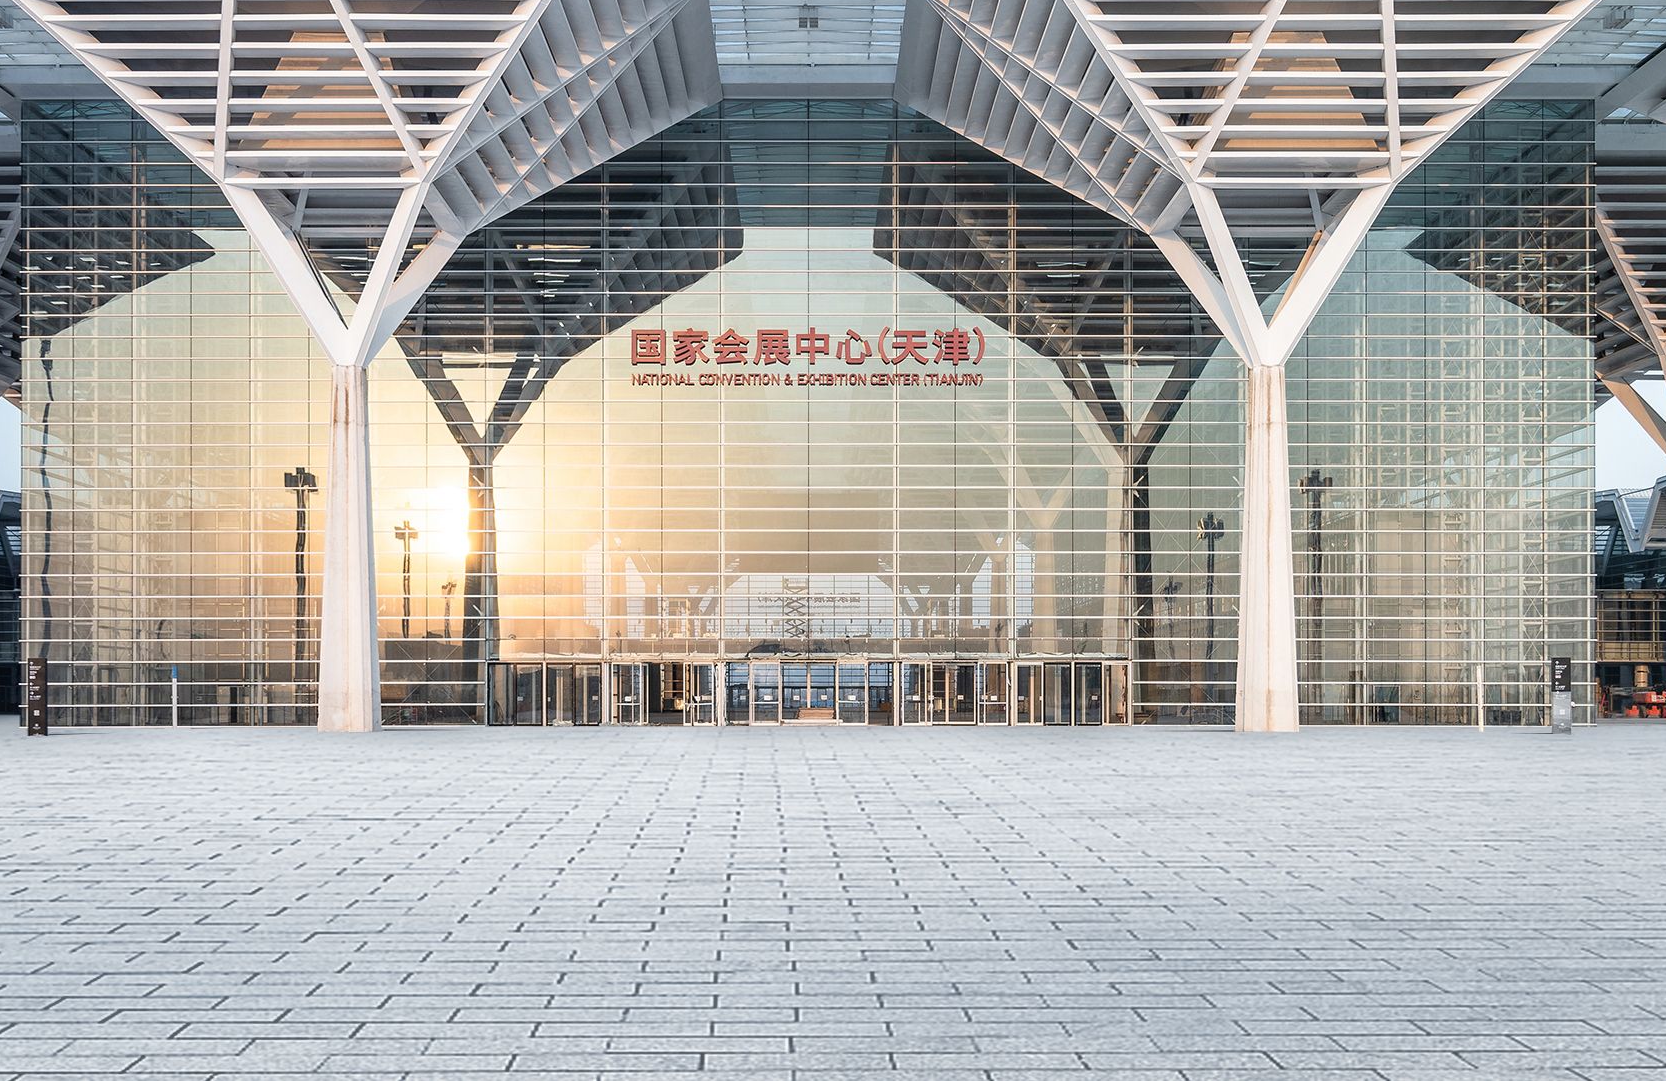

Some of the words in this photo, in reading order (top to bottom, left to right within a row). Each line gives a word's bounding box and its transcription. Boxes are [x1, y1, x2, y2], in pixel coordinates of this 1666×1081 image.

[631, 326, 986, 366] 国家会展中心(天津)
[631, 373, 695, 387] NATIONAL
[698, 373, 781, 387] CONVENTION
[784, 373, 794, 386] &
[797, 373, 867, 387] EXHIBITION
[870, 373, 920, 387] CENTER
[923, 373, 984, 387] (TIANJIN)
